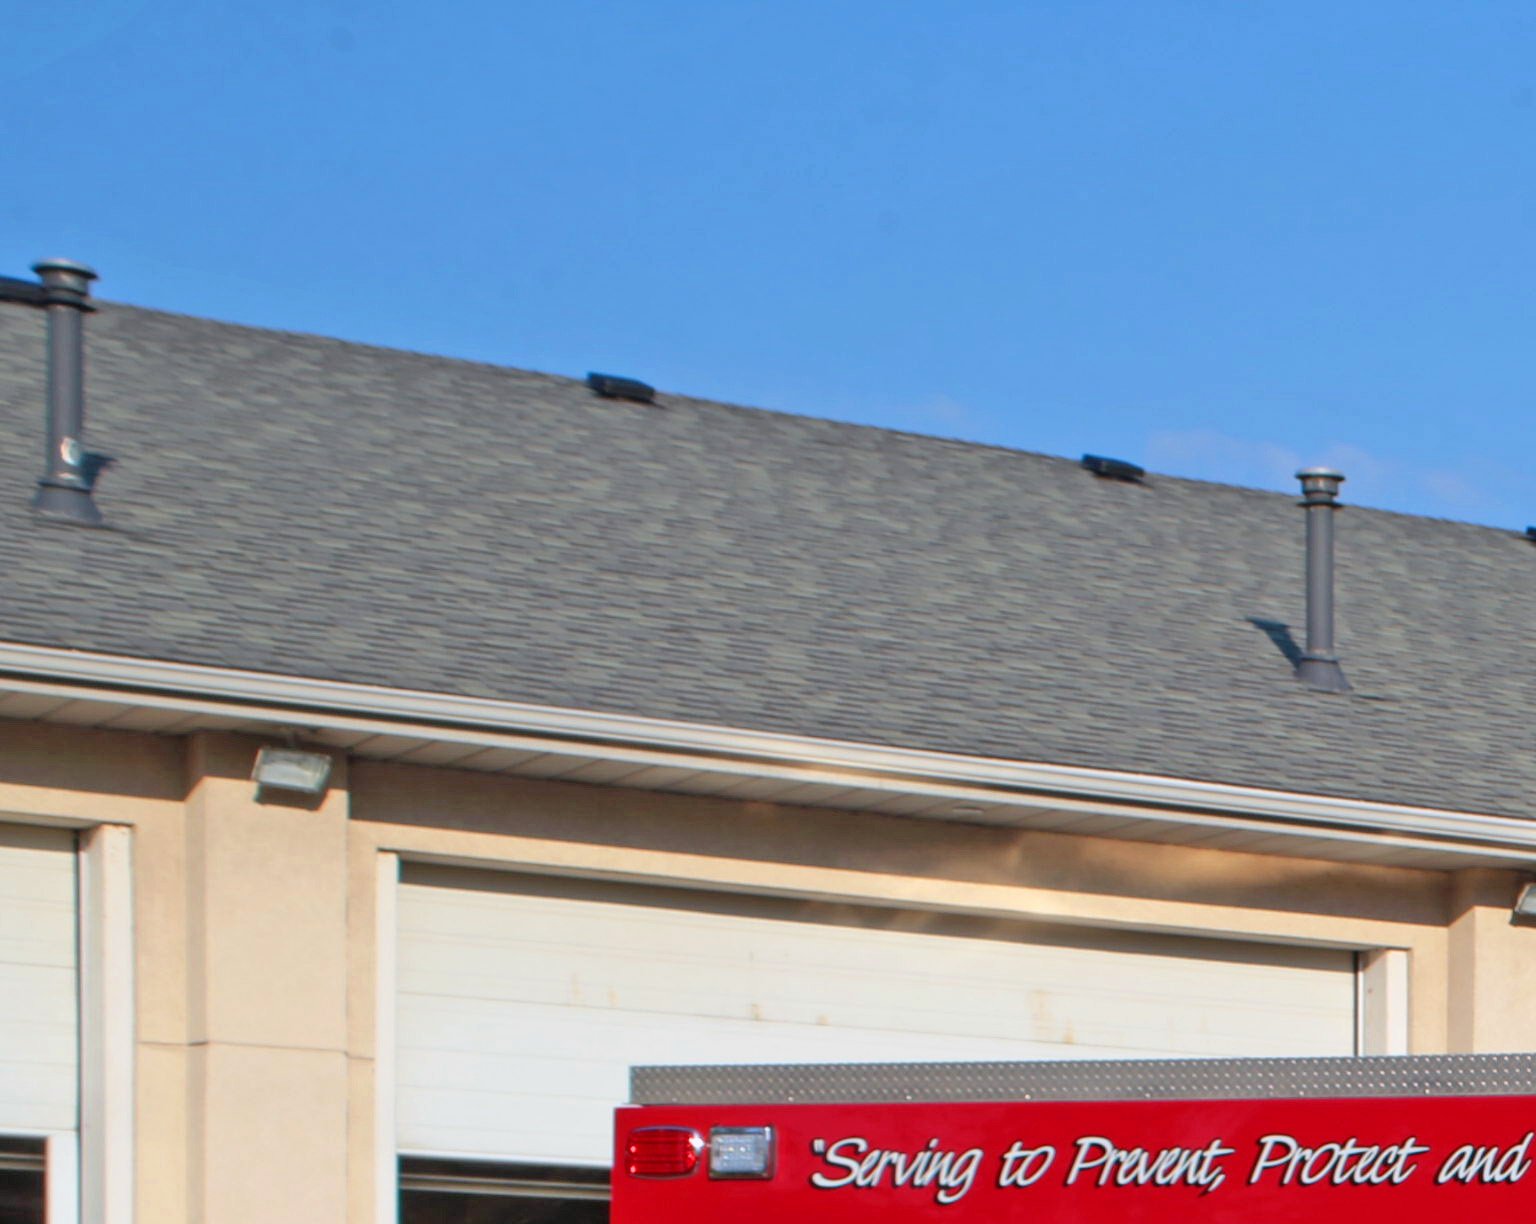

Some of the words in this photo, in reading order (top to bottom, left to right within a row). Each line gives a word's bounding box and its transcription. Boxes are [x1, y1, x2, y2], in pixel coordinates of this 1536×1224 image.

[999, 1140, 1056, 1187] to
[1066, 1136, 1236, 1192] Prevent,
[1250, 1133, 1430, 1185] Protect
[1437, 1131, 1535, 1185] and
